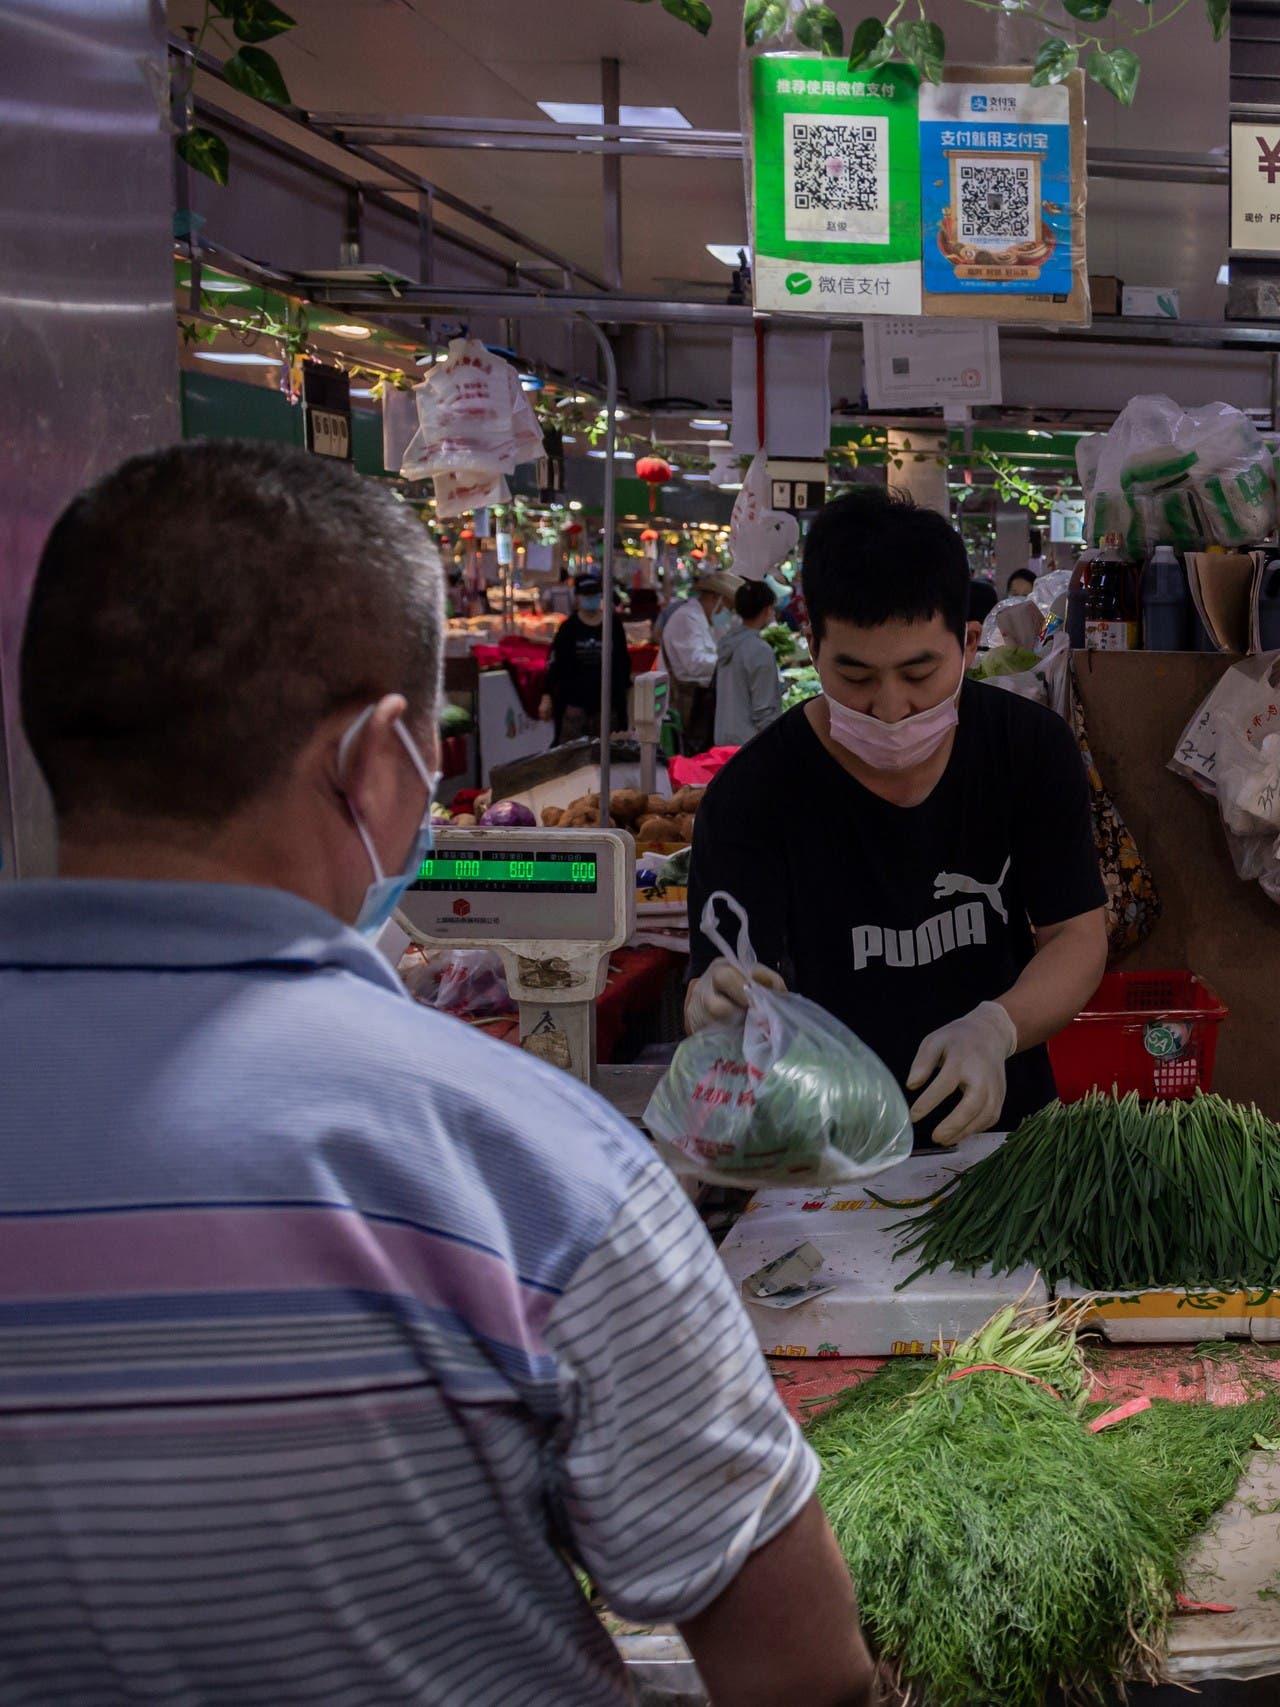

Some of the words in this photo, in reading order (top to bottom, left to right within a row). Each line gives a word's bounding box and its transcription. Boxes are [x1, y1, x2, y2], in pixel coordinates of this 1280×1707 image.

[775, 78, 896, 98] 推荐使用微信支付
[989, 97, 1017, 107] 支付宝
[940, 131, 1049, 149] 支付就用支付宝
[818, 275, 891, 296] 微信支付
[851, 901, 987, 971] PUMA
